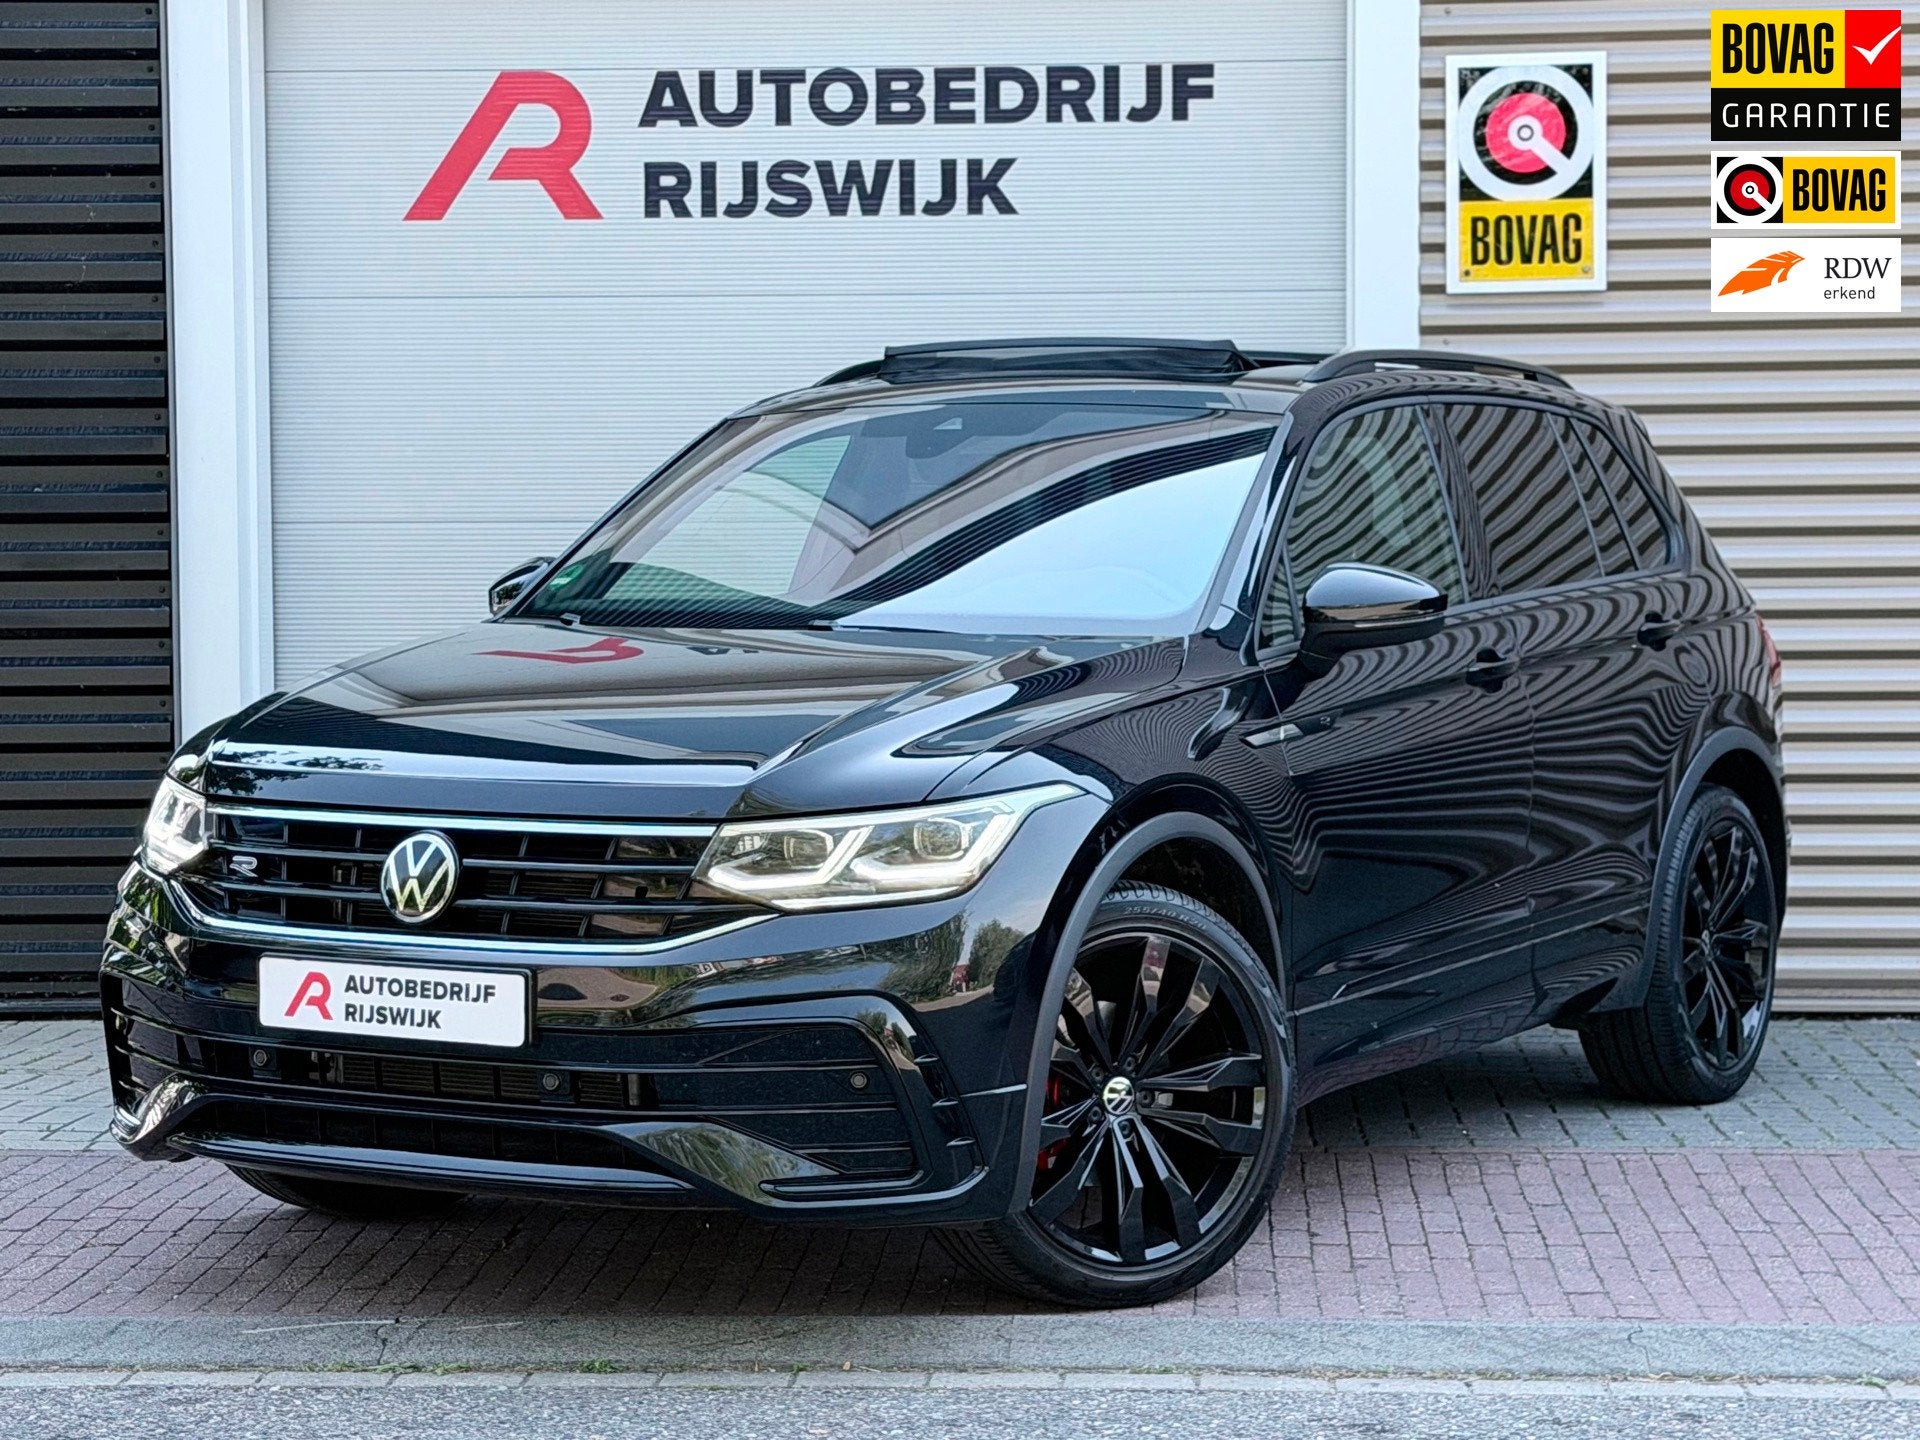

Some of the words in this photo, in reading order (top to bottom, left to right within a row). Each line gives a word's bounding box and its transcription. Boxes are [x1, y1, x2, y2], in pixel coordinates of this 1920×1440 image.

[637, 64, 1215, 128] AUTOBEDRIJF
[643, 157, 1020, 219] RIJSWIJK
[1470, 212, 1583, 267] BOVAG
[344, 974, 497, 1004] AUTOBEDRIJF
[344, 1003, 442, 1029] RIJSWIJK
